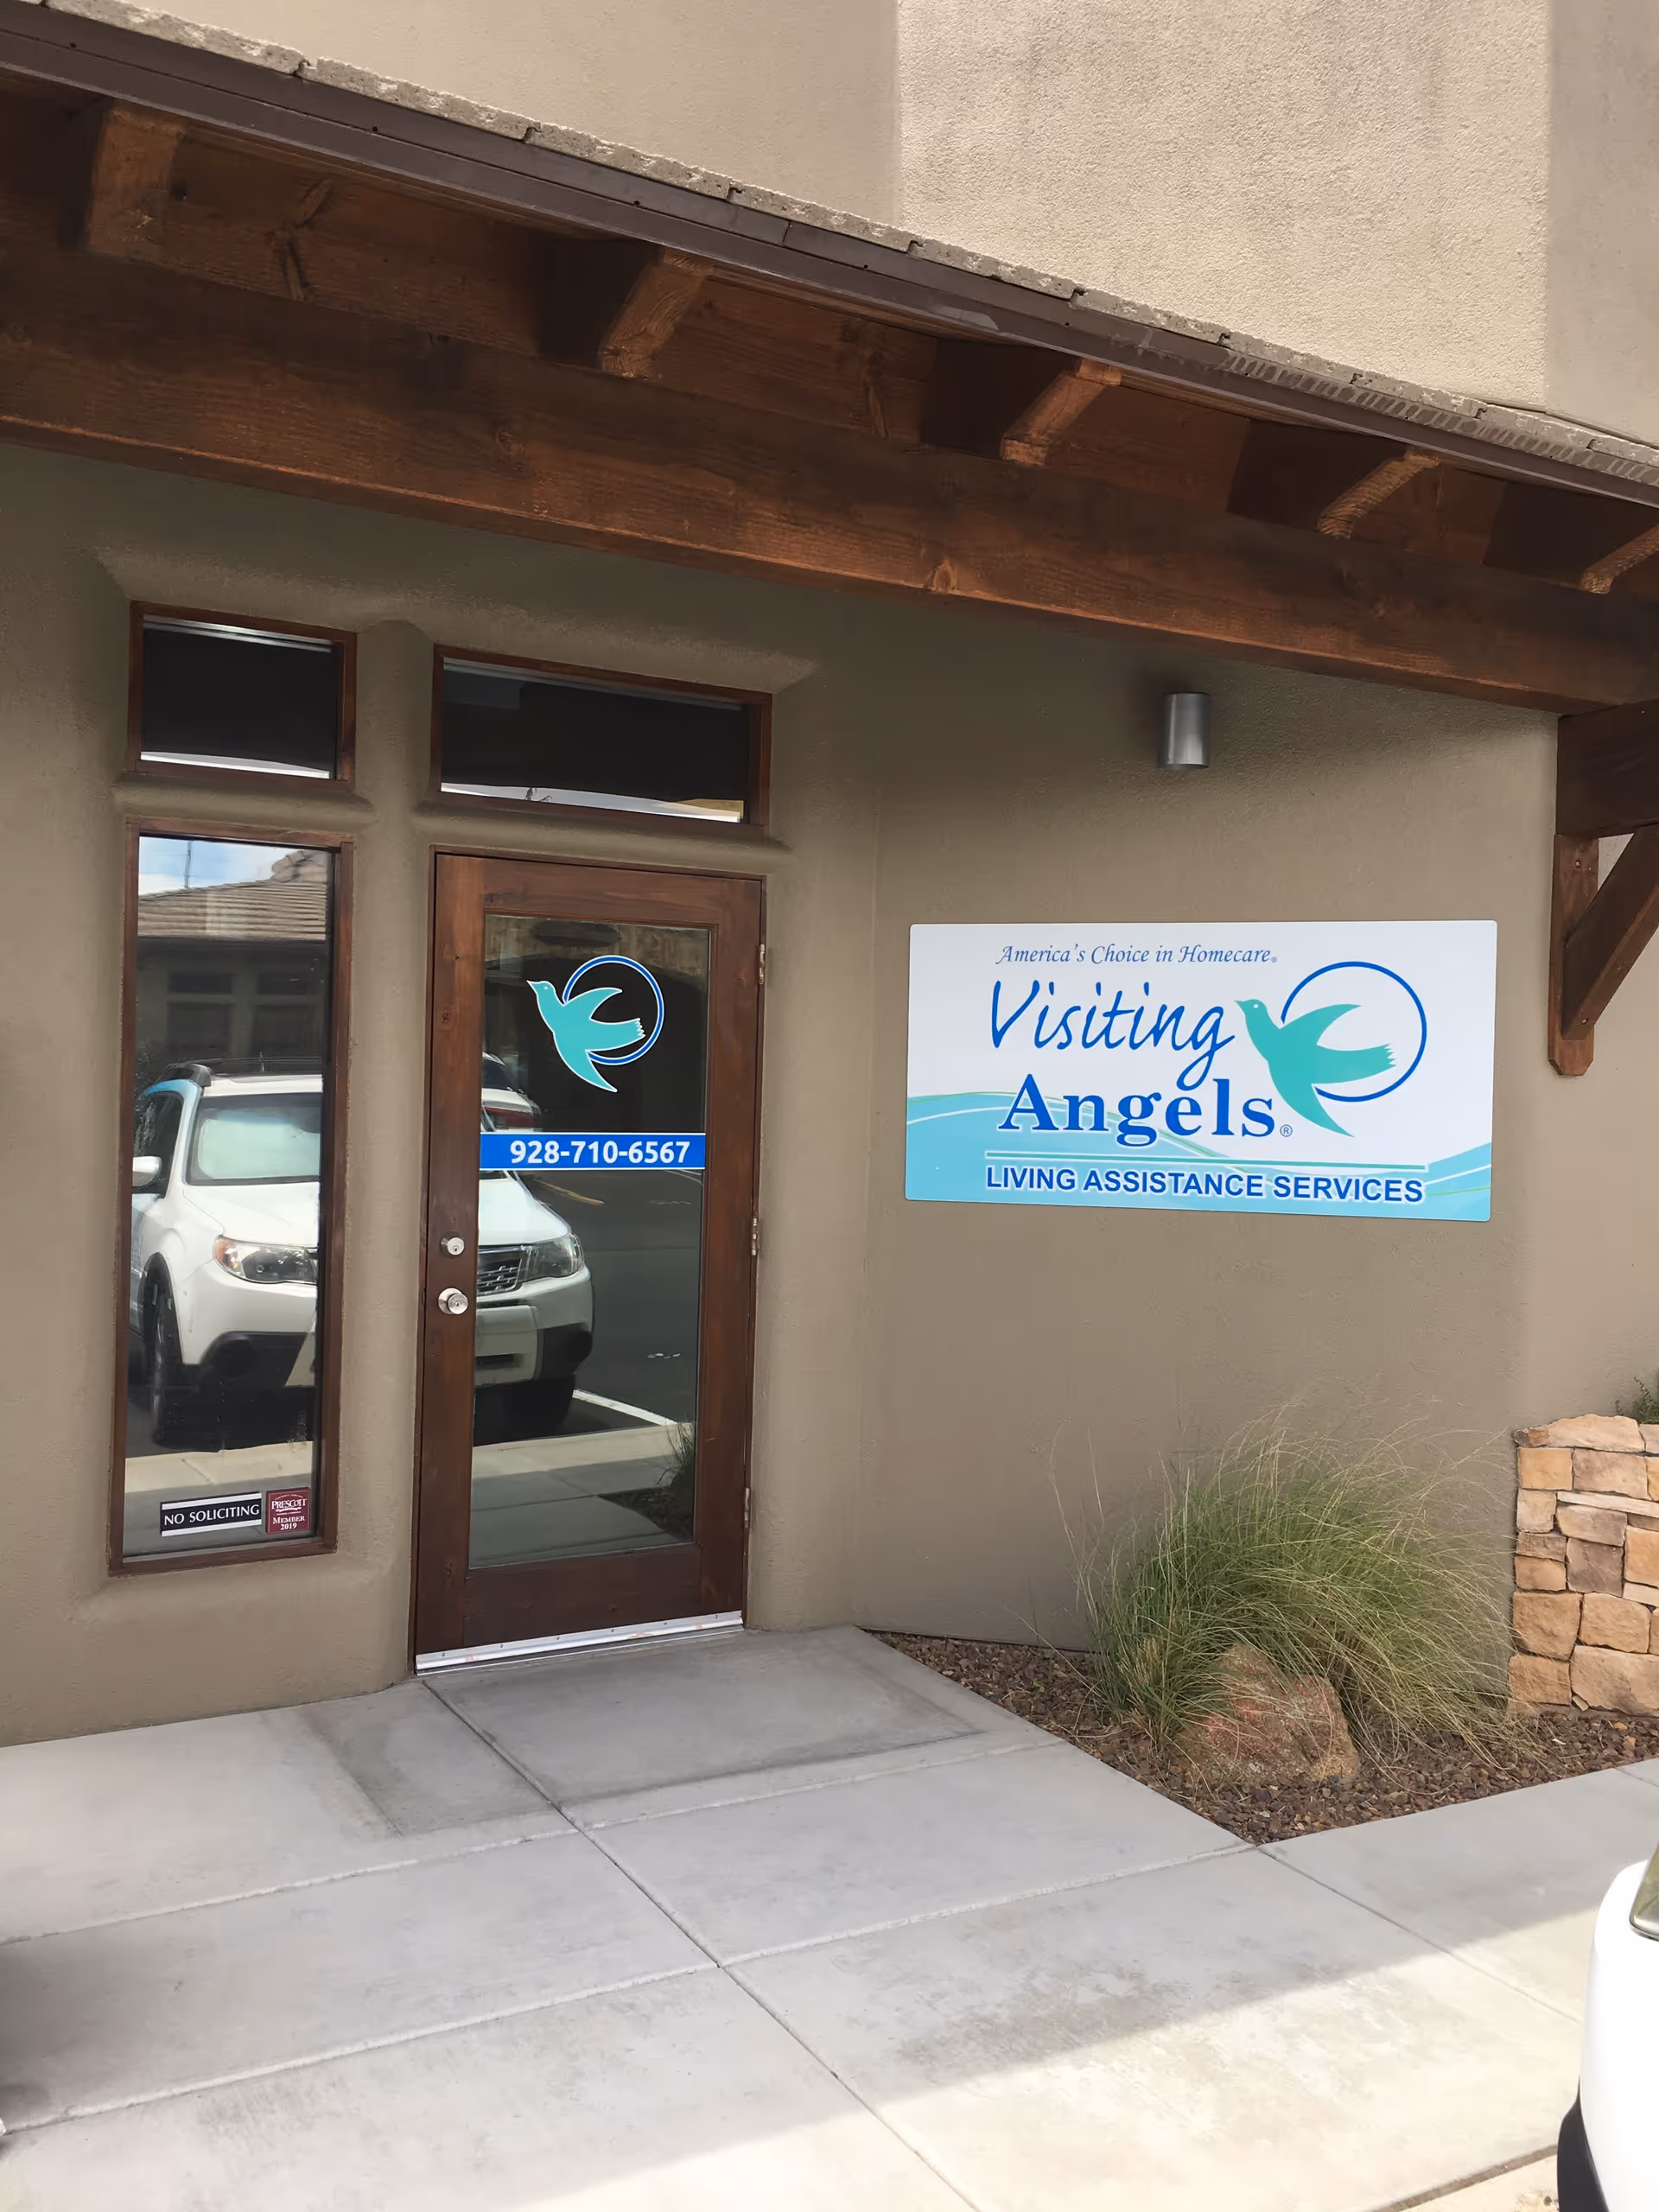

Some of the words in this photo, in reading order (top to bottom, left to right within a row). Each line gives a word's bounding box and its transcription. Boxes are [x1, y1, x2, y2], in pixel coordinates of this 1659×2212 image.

[995, 944, 1085, 965] America's
[1090, 944, 1149, 965] Choice
[1155, 945, 1173, 963] in
[990, 980, 1235, 1091] Visiting
[510, 1140, 690, 1164] 928-710-6567
[987, 1166, 1075, 1191] LIVING
[1083, 1168, 1263, 1198] ASSISTANCE
[1273, 1177, 1423, 1203] SERVICES
[271, 1498, 307, 1510] PRESCOTT
[164, 1513, 184, 1526] NO
[189, 1504, 259, 1522] SOLICITING
[272, 1516, 305, 1525] MEMBER
[280, 1522, 297, 1531] 2019
